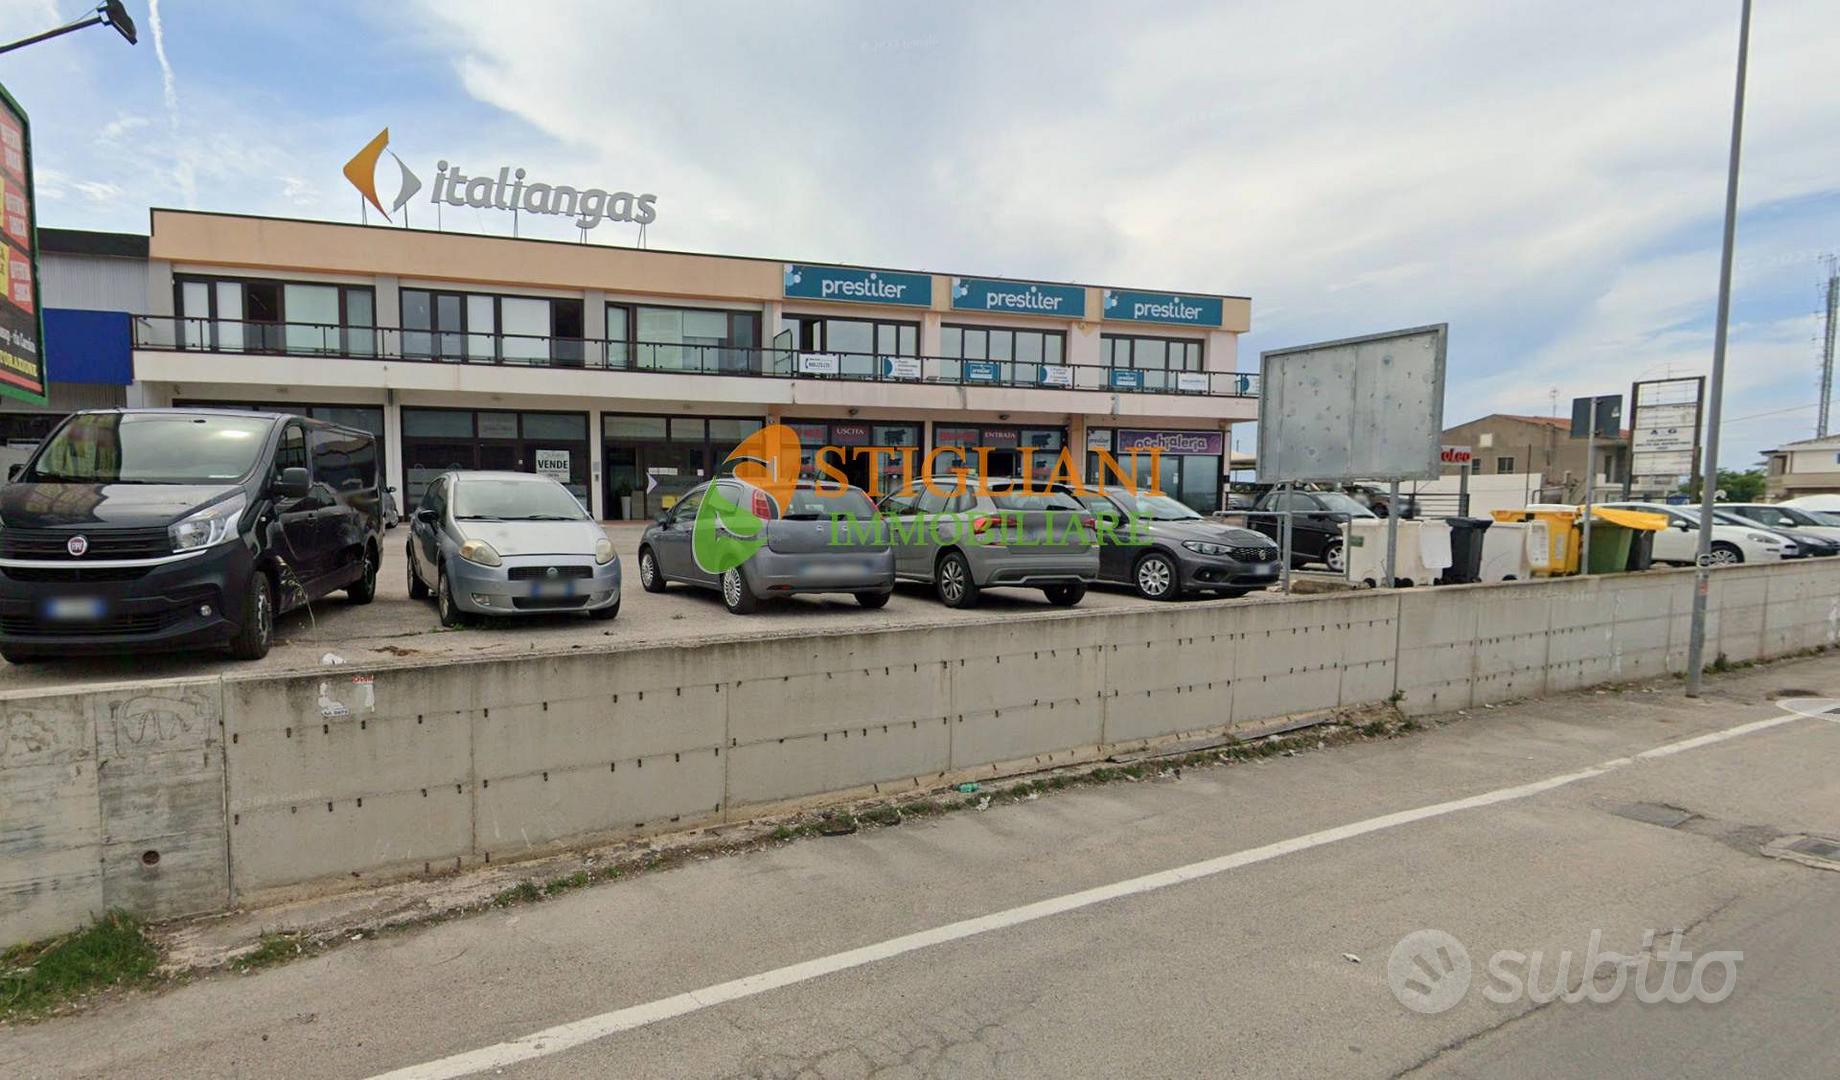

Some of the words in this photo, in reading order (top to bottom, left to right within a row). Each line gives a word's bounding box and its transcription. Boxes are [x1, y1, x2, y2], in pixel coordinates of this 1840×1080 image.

[431, 159, 658, 229] italiangas
[822, 273, 906, 298] prestiter
[986, 286, 1063, 310] prestiter
[1134, 297, 1203, 320] prestiter
[836, 427, 865, 435] USCITA
[537, 459, 569, 470] VENDE
